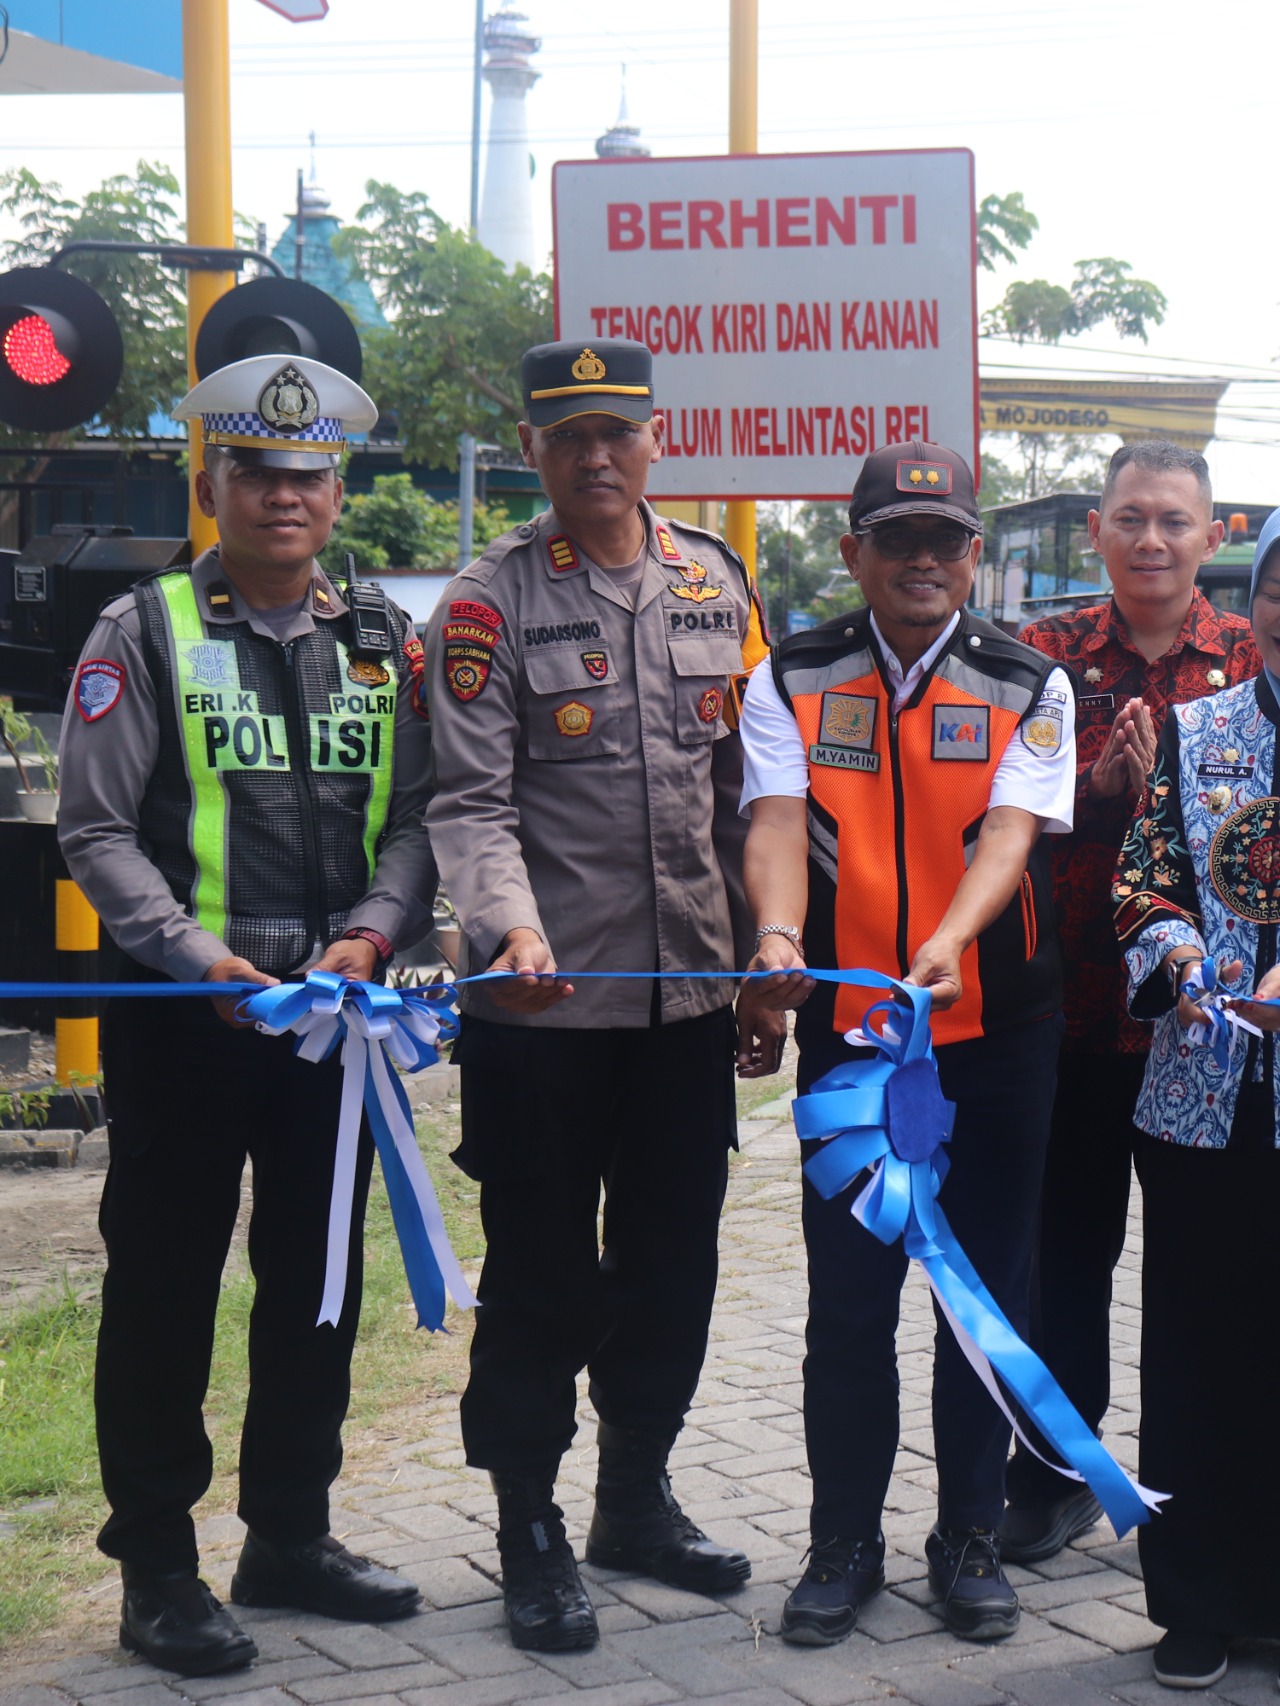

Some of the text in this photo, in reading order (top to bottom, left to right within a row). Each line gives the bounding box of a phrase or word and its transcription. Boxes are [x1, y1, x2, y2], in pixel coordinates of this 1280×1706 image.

[606, 194, 917, 252] BERHENTI
[590, 299, 940, 356] TENGOK KIRI DAN KANAN
[731, 405, 876, 458] MELINTASI
[453, 603, 498, 625] PELOPOR
[670, 611, 732, 631] POLRI
[447, 626, 495, 644] BAHARKAM
[523, 620, 602, 647] SUDARSONO
[185, 693, 223, 714] ERI
[332, 695, 394, 715] POLRI
[1079, 699, 1102, 707] ENNY
[938, 722, 983, 743] KAI
[815, 748, 876, 769] M.YAMIN
[1205, 766, 1248, 776] NURUL A.
